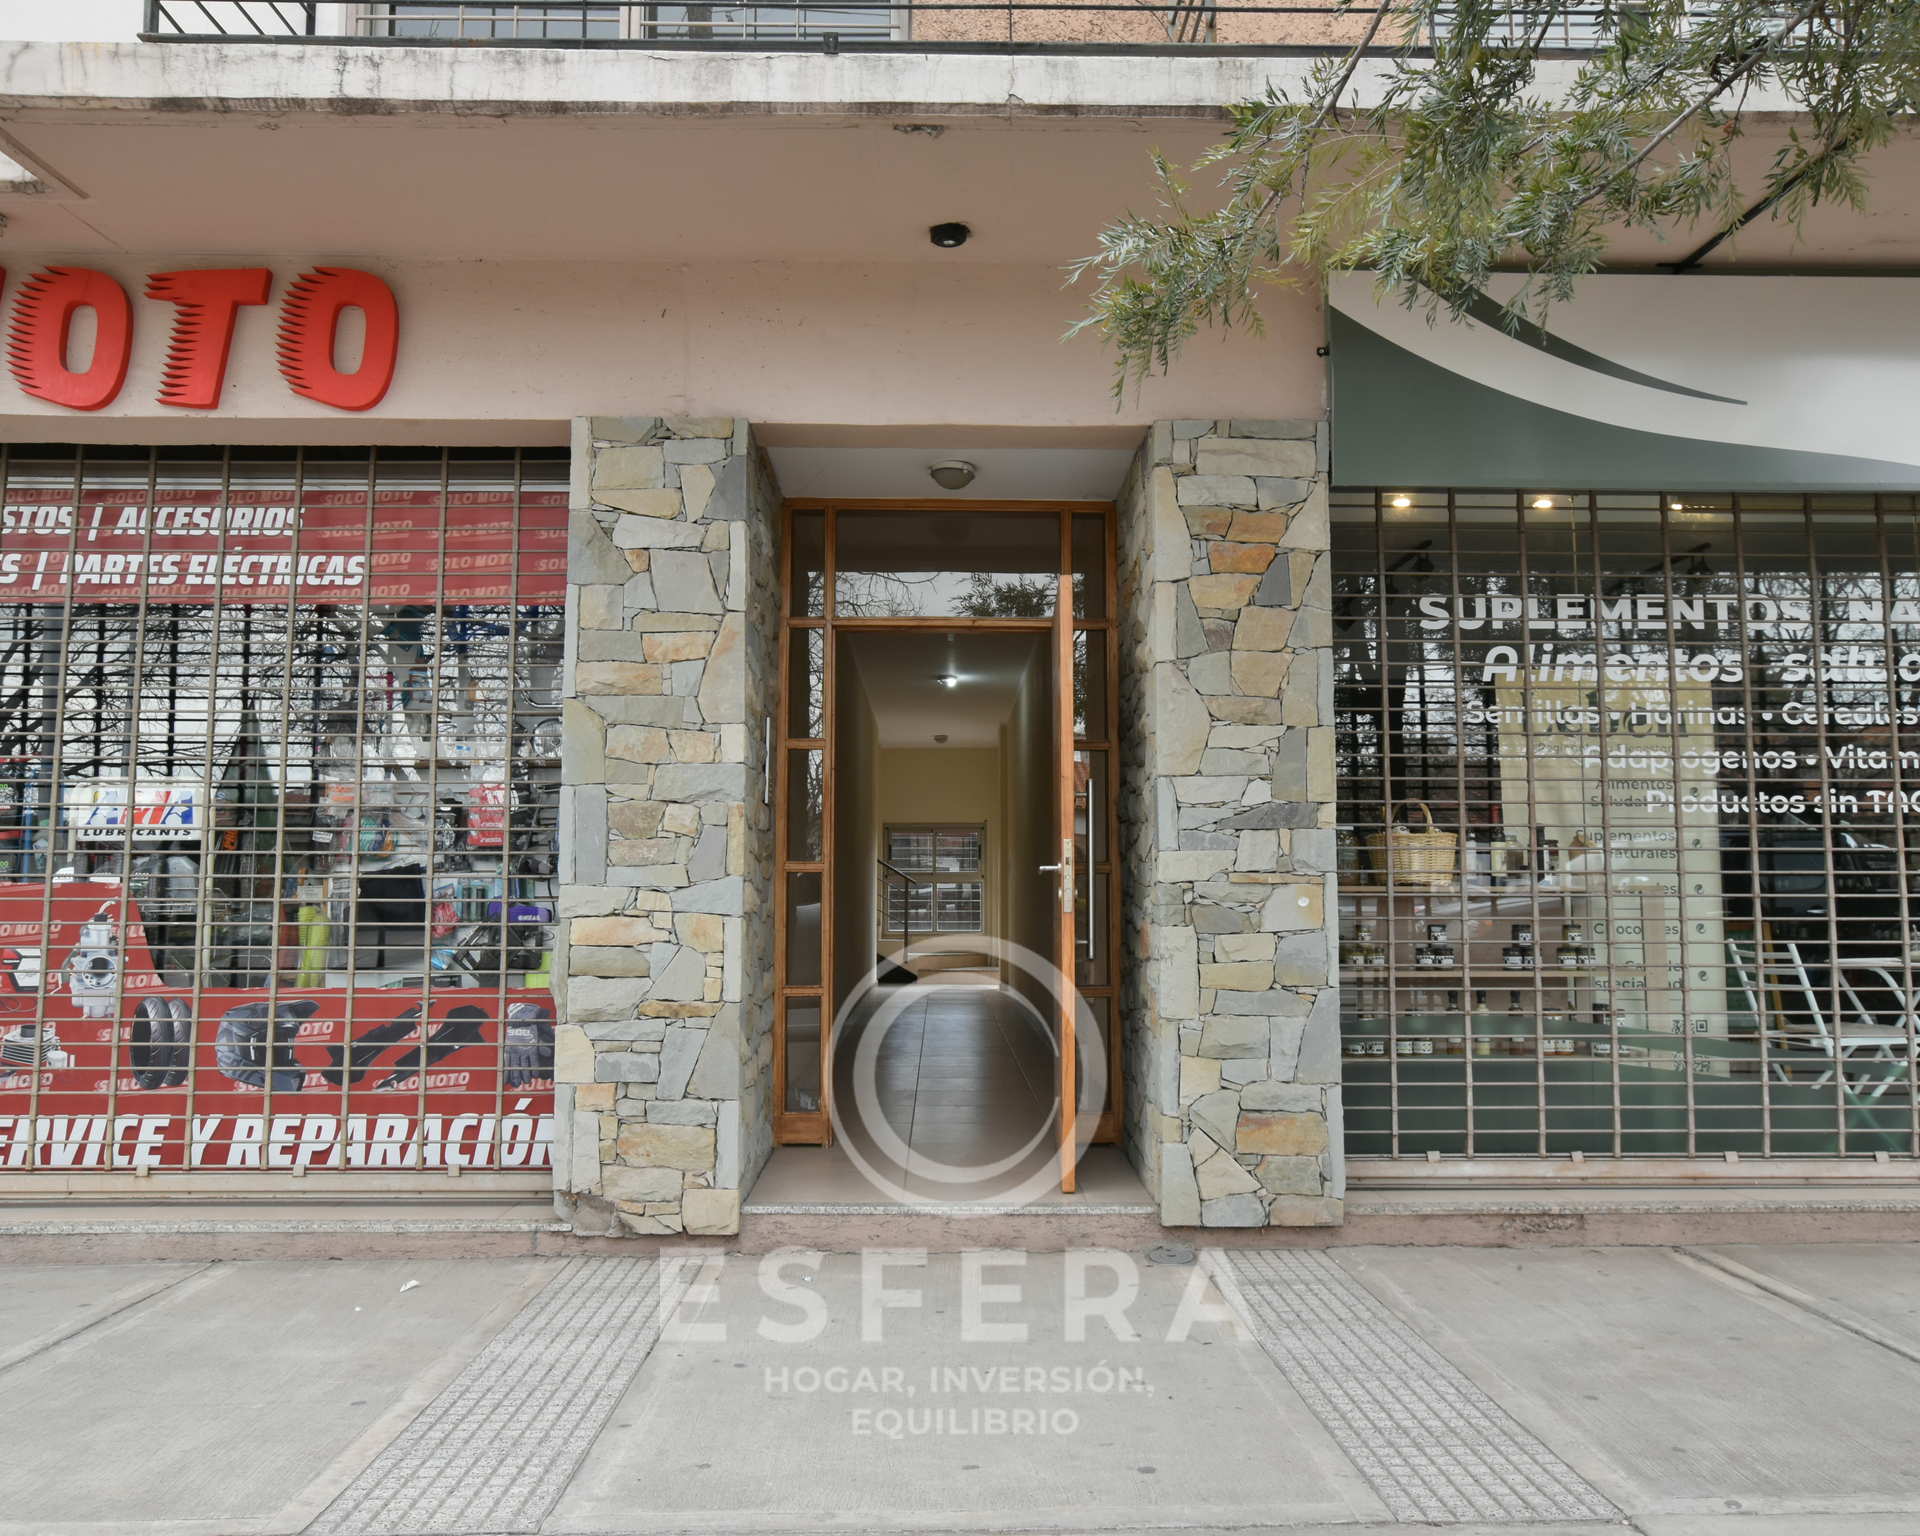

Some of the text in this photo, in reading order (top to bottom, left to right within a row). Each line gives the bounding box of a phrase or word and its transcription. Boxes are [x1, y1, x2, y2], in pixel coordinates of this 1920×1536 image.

[0, 265, 400, 412] OTO
[540, 494, 569, 505] SOL
[1, 506, 305, 536] STOS ACCESORIOS
[535, 528, 569, 539] SOL
[0, 546, 366, 586] S PARTES ELÉCTRICAS
[535, 558, 569, 571] SOL
[1419, 593, 1813, 630] SUPLEMENTOS
[1482, 643, 1744, 682] Alimentos
[1466, 700, 1601, 724] Semillas
[1781, 701, 1919, 726] Cereales
[1648, 789, 1806, 814] Productos
[1814, 788, 1858, 814] sin
[83, 827, 192, 837] LUBRCANTS
[297, 1021, 334, 1037] OTO
[193, 1114, 225, 1167] Y
[226, 1097, 556, 1168] REPARACIÓN
